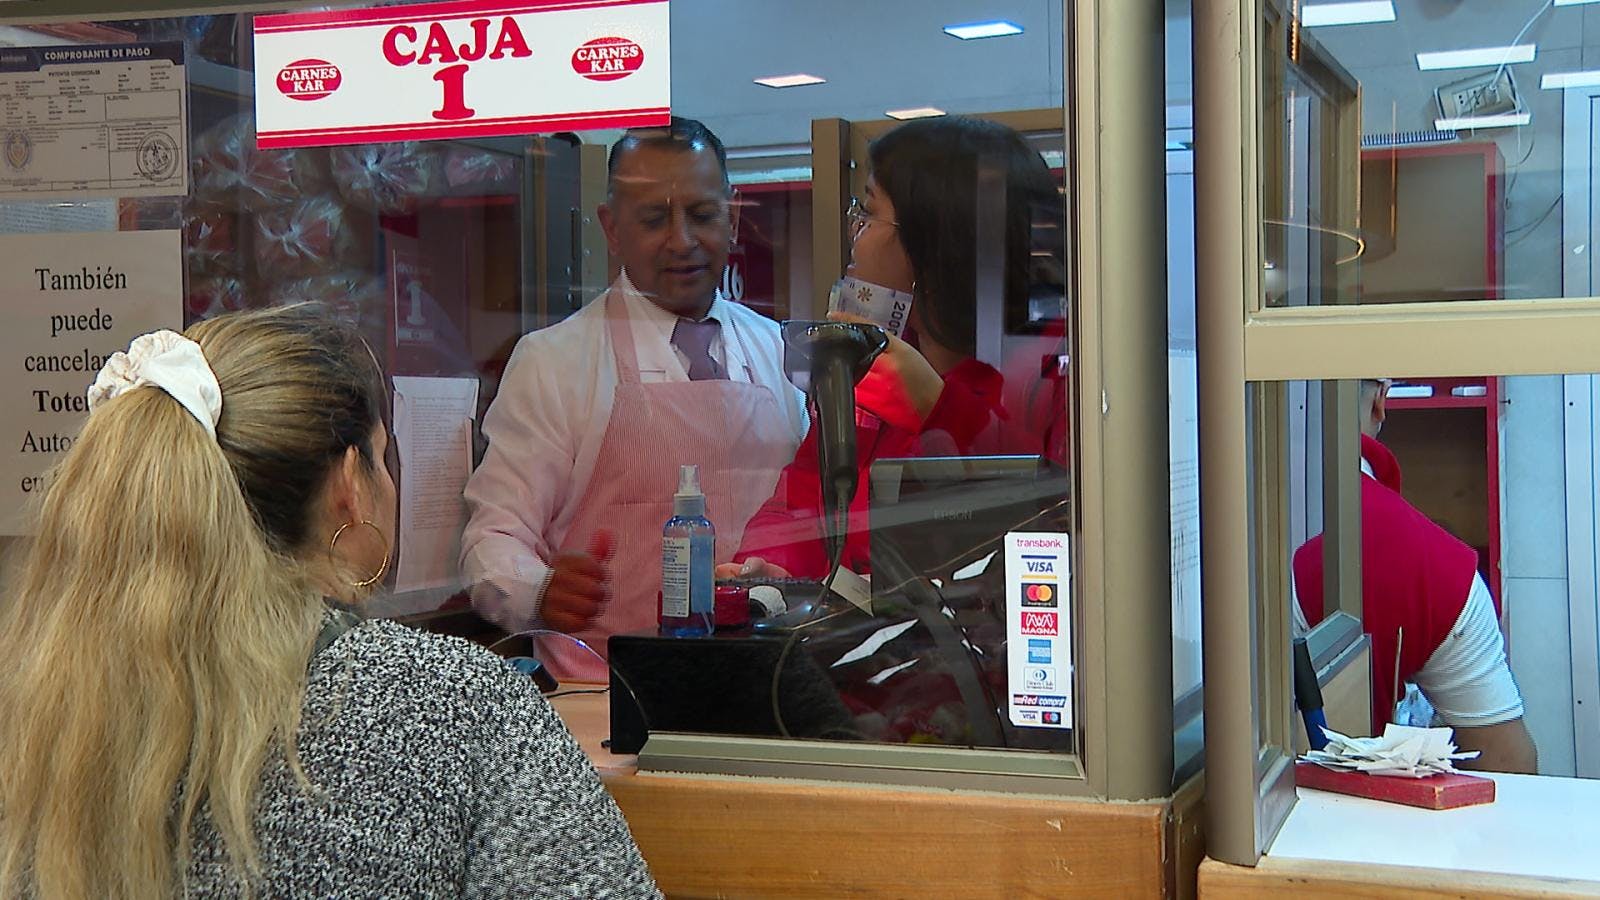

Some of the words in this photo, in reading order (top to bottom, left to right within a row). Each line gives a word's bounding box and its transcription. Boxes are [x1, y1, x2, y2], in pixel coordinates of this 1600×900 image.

[383, 16, 532, 66] CAJA
[44, 50, 110, 60] COMPROBANTE
[112, 49, 124, 57] DE
[125, 47, 151, 56] PAGO
[577, 46, 639, 61] CARNES
[590, 58, 625, 73] KAR
[281, 67, 337, 82] CARNES
[293, 79, 325, 92] KAR
[432, 64, 475, 120] 1
[34, 266, 127, 291] También
[50, 308, 113, 337] puede
[1027, 562, 1053, 572] VISA
[1022, 627, 1057, 635] MAGNA
